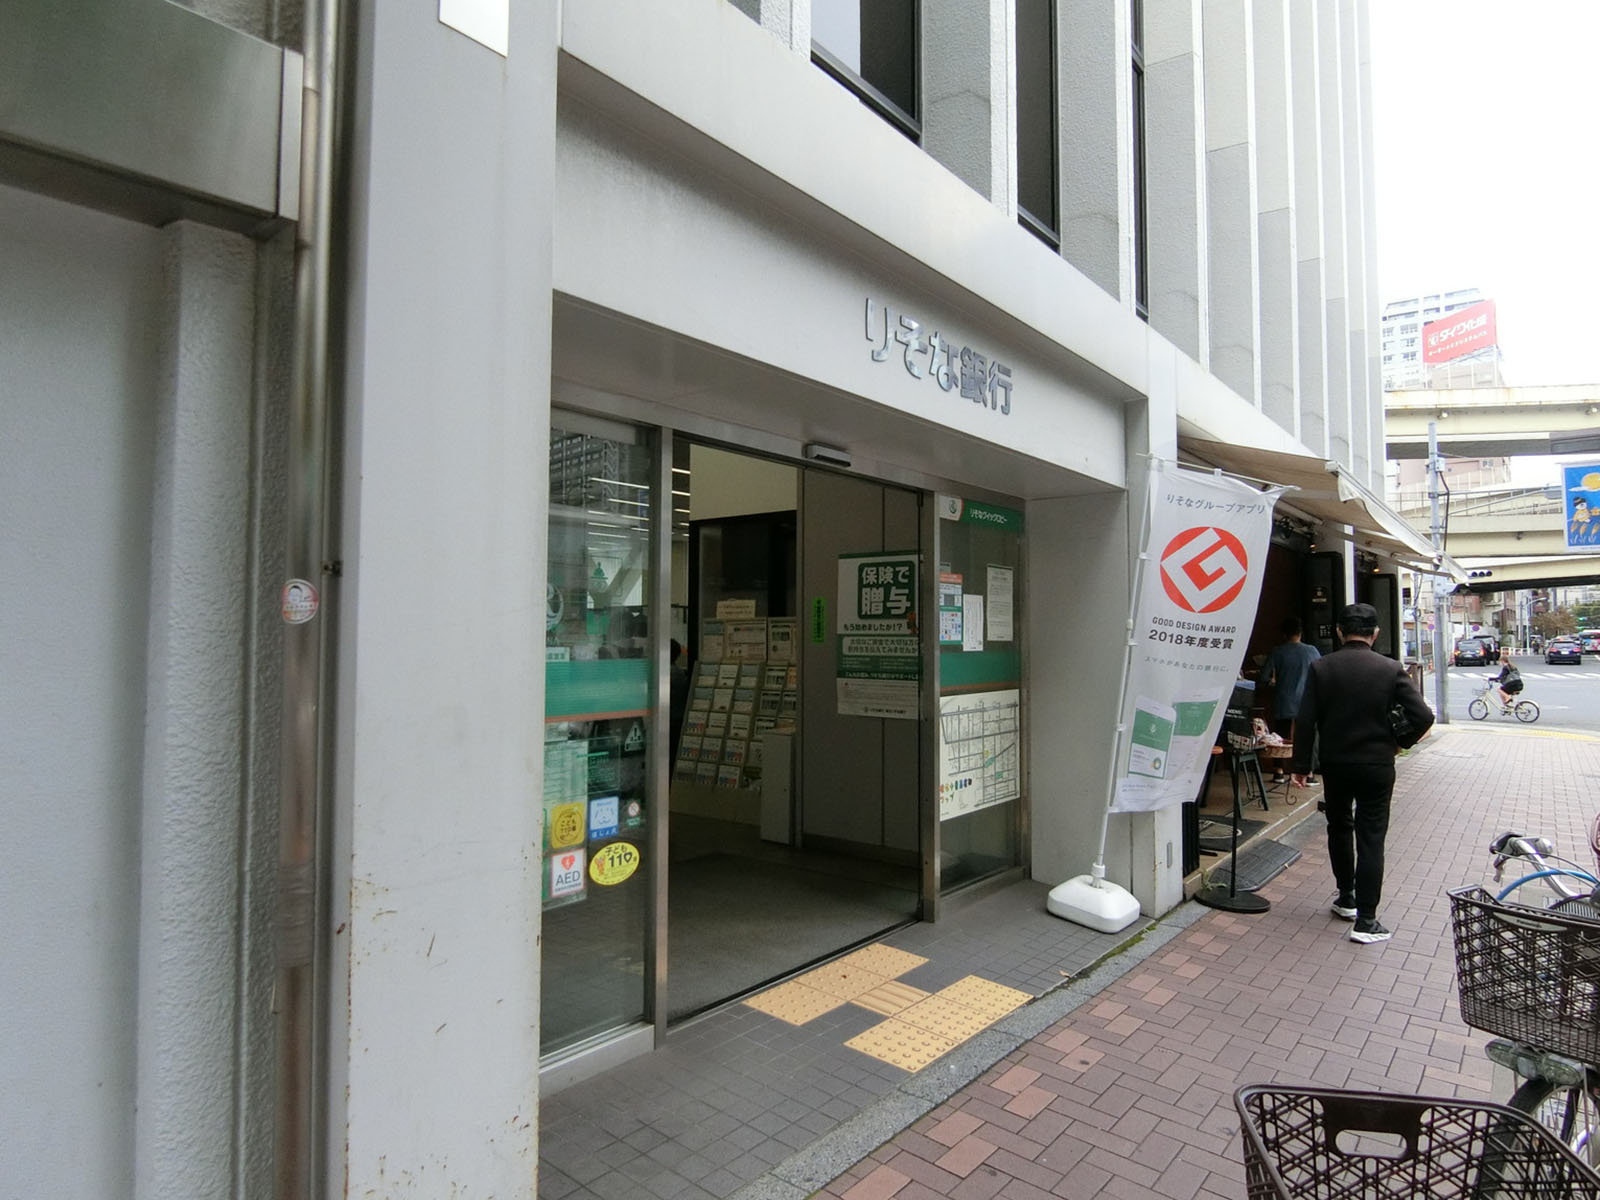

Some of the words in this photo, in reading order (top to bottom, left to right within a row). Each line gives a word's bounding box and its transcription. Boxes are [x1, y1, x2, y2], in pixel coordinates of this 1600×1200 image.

[865, 298, 1013, 415] りそな銀行
[1166, 493, 1266, 514] りそなグループアプリ
[862, 565, 910, 585] 保険で
[861, 586, 911, 616] 贈与
[1152, 616, 1174, 628] GOOD
[1176, 620, 1206, 632] DESIGN
[1208, 624, 1236, 634] AWARD
[1148, 629, 1234, 650] 2018年度受賞
[605, 844, 628, 856] 子ども
[555, 870, 581, 886] AED
